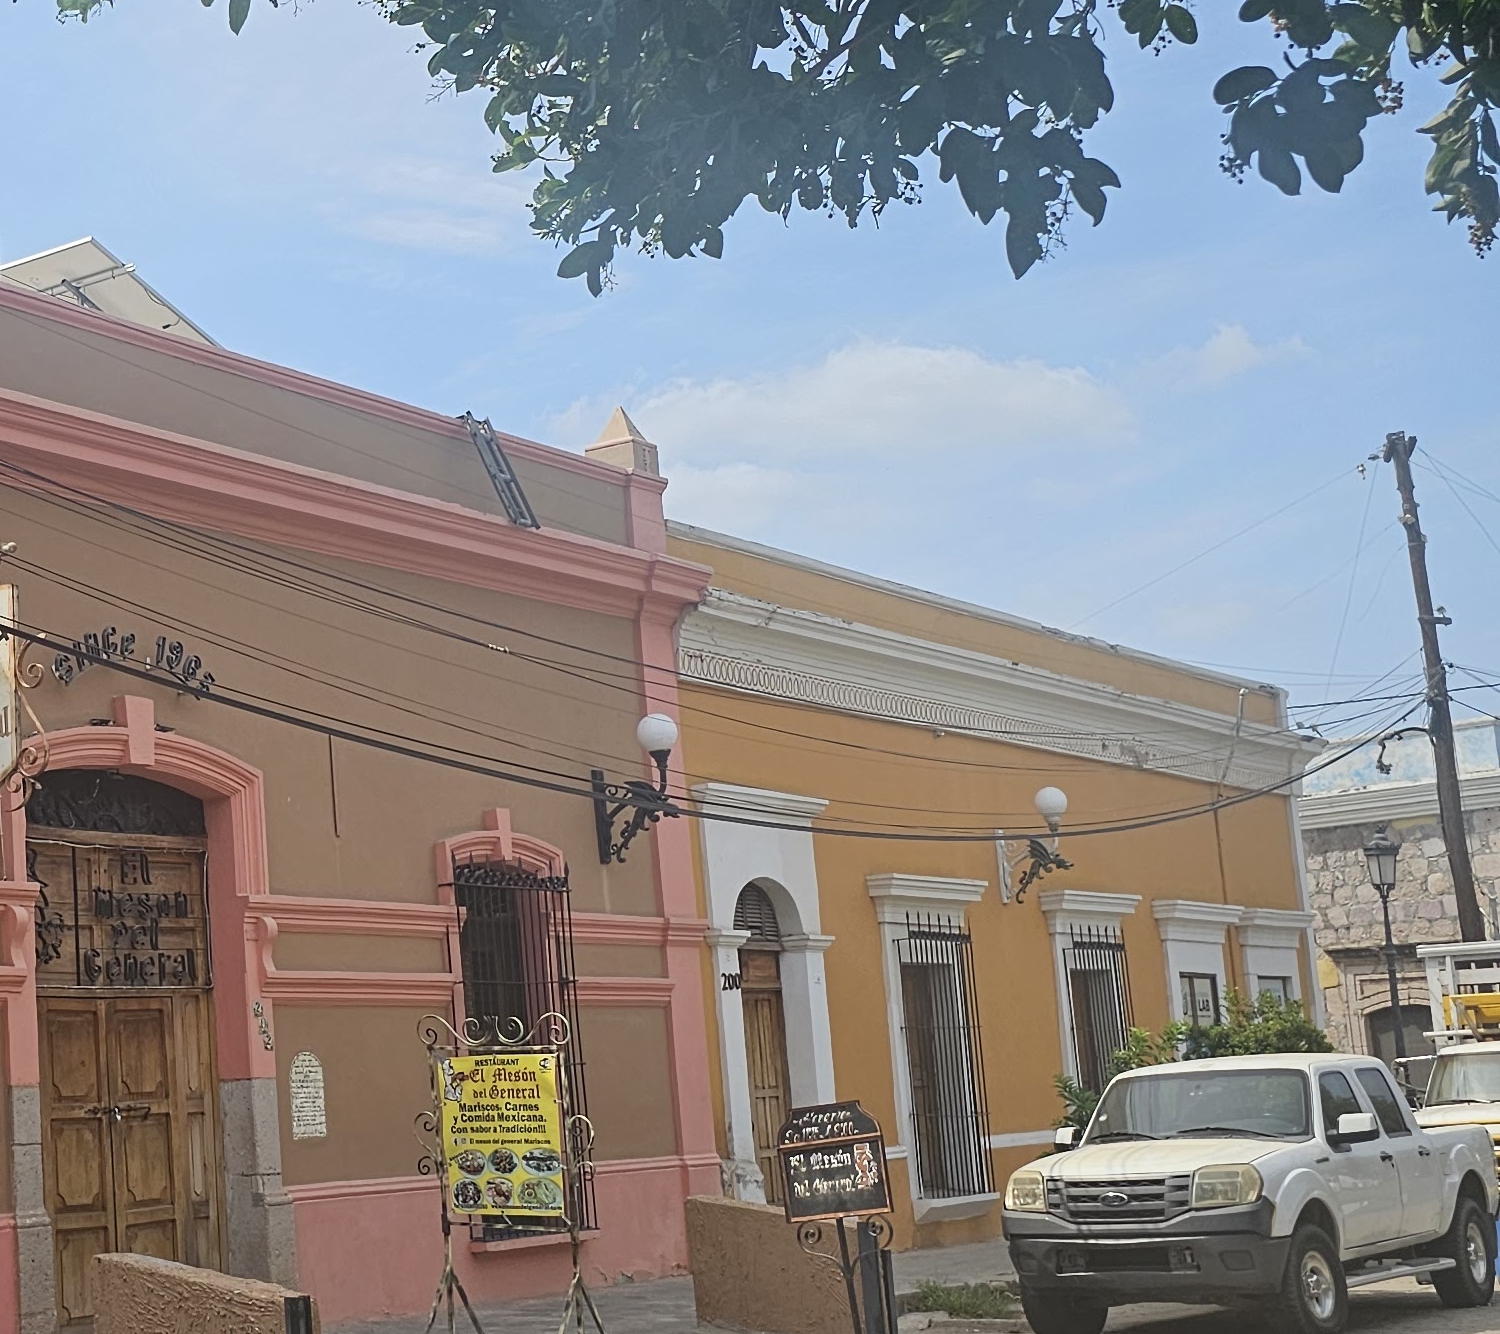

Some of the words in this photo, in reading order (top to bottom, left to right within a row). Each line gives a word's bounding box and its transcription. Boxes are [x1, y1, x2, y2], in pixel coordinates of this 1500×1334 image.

[119, 851, 153, 885] El
[721, 972, 741, 991] 200
[474, 1058, 519, 1067] RESTAURANT
[469, 1068, 485, 1083] El
[492, 1067, 537, 1083] Mesón
[473, 1088, 487, 1099] del
[489, 1084, 541, 1099] General
[504, 1102, 540, 1112] Carnes
[452, 1115, 458, 1125] y
[460, 1112, 495, 1123] Comida
[450, 1125, 468, 1134] Con
[469, 1124, 491, 1134] sabor
